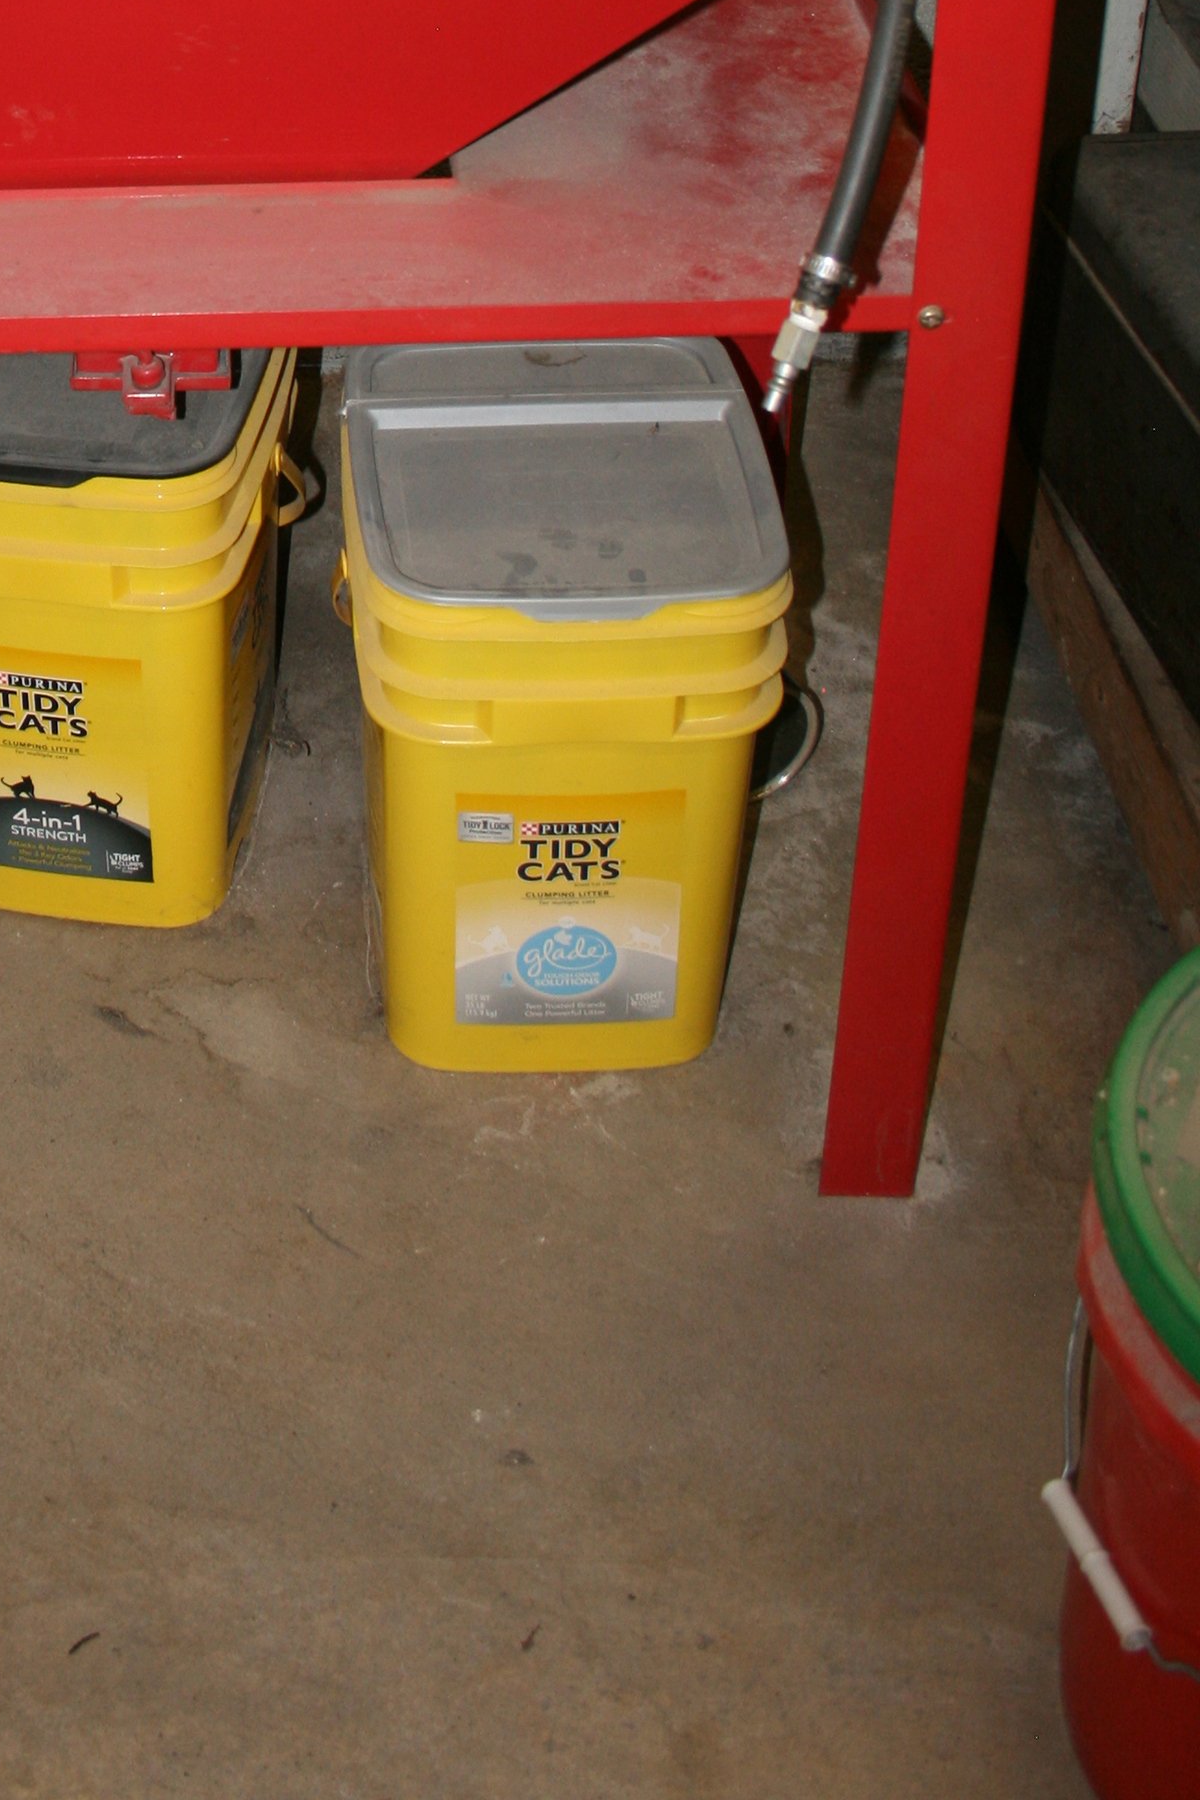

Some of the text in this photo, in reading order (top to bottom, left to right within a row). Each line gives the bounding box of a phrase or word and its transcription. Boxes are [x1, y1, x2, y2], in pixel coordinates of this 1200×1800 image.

[10, 675, 80, 693] PURINA
[2, 739, 48, 750] CLUMPING
[12, 807, 82, 831] 4-in-1
[464, 821, 510, 830] TIDY LOCK
[10, 824, 87, 843] STRENGTH
[542, 823, 615, 834] PURINA
[113, 853, 140, 862] TIGHT
[521, 838, 616, 859] TIDY
[518, 860, 619, 881] CATS
[524, 936, 600, 977] glade
[535, 978, 600, 986] SOLUTIONS
